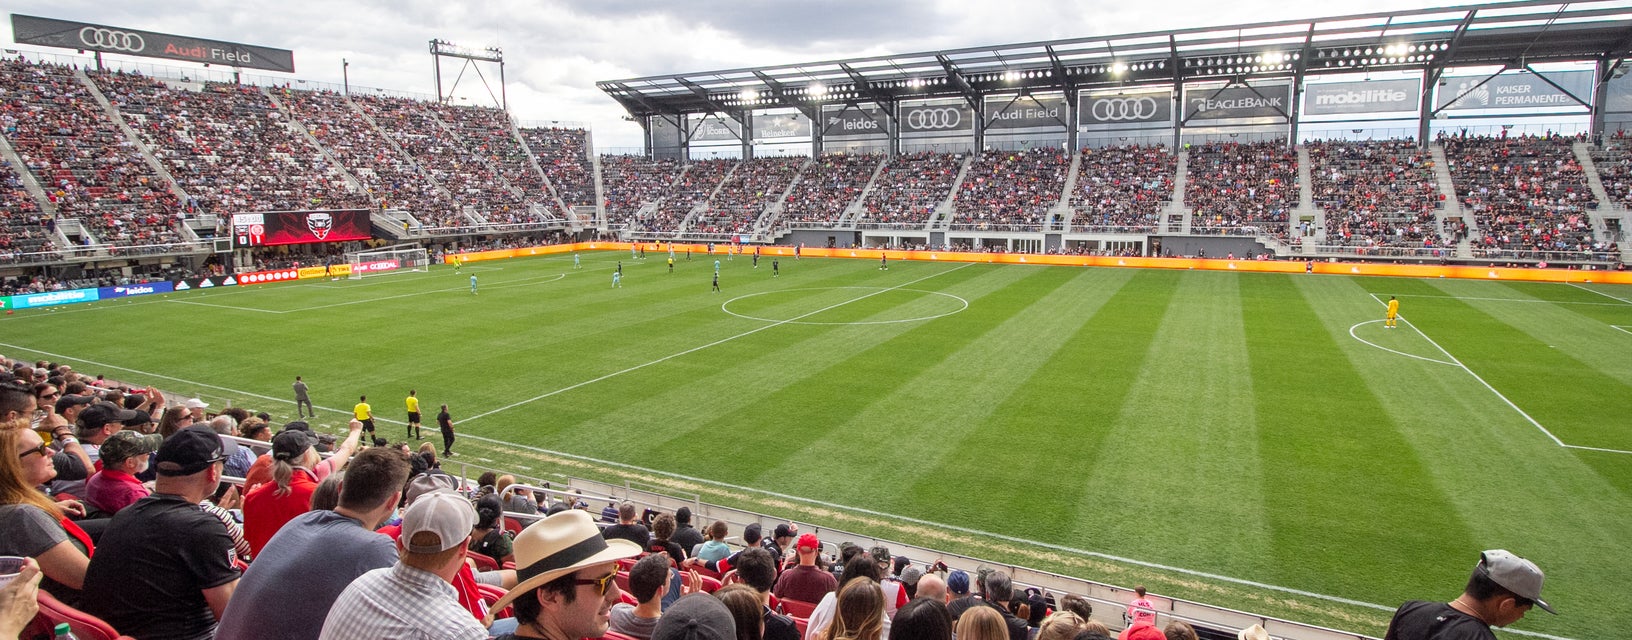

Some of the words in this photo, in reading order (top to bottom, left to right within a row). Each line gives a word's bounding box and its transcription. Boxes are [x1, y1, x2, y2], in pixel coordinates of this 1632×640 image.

[164, 43, 208, 59] Audi
[211, 48, 251, 63] Field
[1496, 84, 1532, 94] KAISER
[1316, 89, 1406, 105] mobilitie
[1495, 95, 1566, 105] PERMANENTE
[1205, 96, 1282, 110] EAGLEBANK
[991, 107, 1023, 121] Audi
[1026, 106, 1059, 119] Field
[843, 117, 879, 131] leidos
[761, 128, 797, 138] Heineken
[239, 236, 247, 245] 0
[256, 236, 260, 244] 1
[127, 286, 154, 294] leidos
[28, 292, 86, 302] mobilitie
